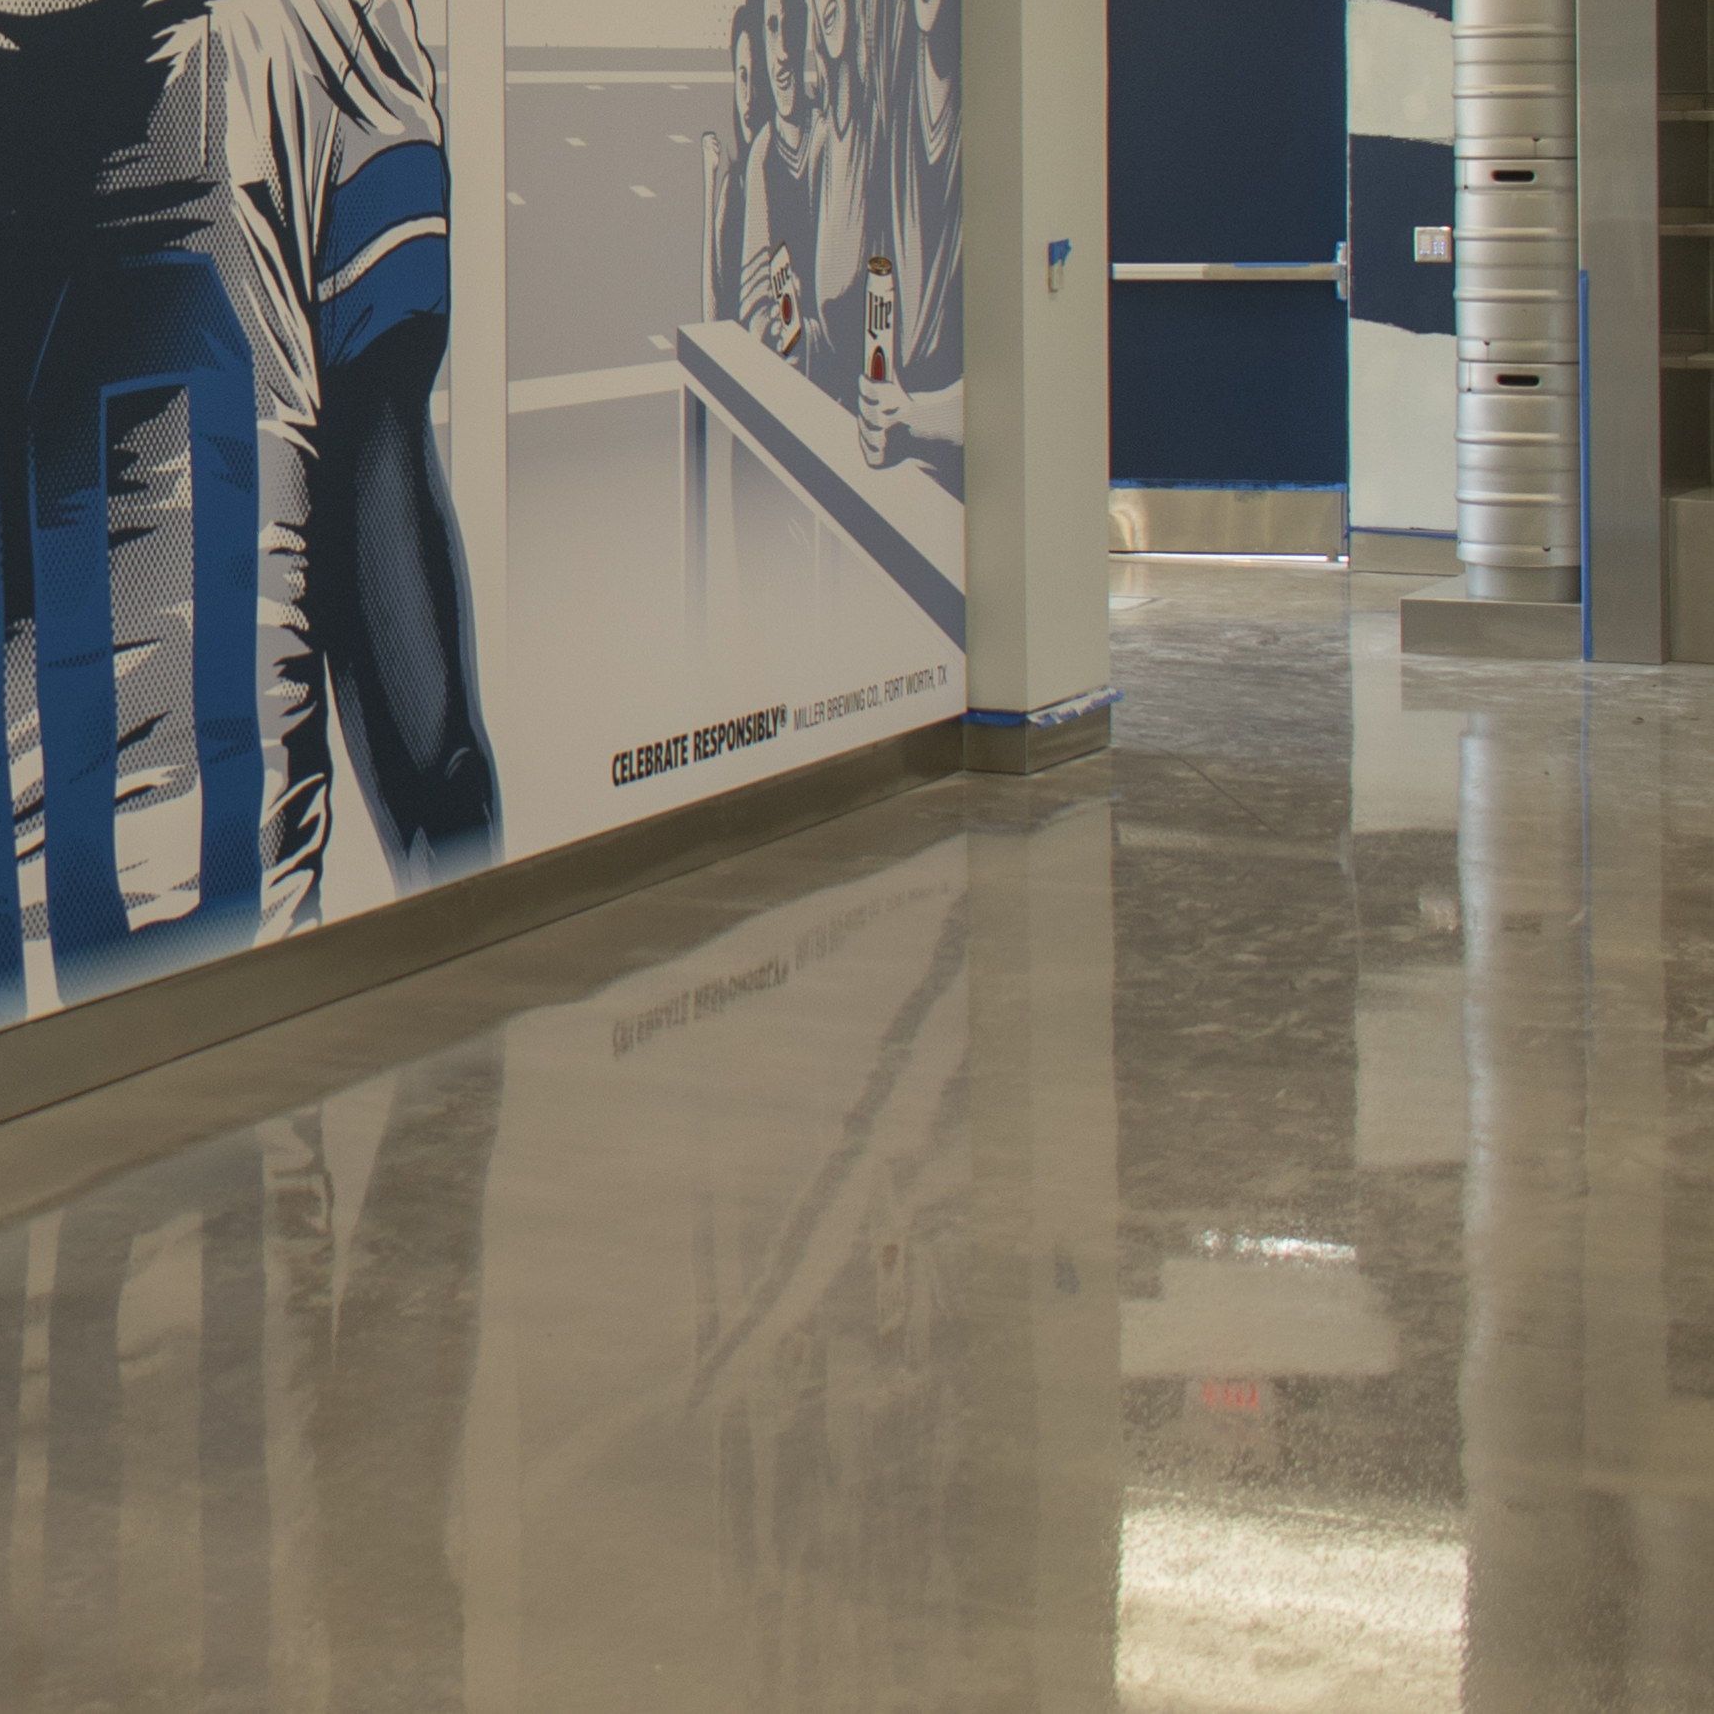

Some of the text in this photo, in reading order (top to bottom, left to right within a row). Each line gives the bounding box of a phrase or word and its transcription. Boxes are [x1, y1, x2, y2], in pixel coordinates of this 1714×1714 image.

[867, 290, 892, 339] Lite
[612, 733, 689, 787] CELEBRATE
[794, 701, 826, 731] MILLER
[827, 688, 866, 721] BREWING
[867, 684, 883, 708] CO.,
[884, 676, 904, 702] FORT
[905, 669, 935, 692] WORTH,
[937, 665, 948, 686] TX
